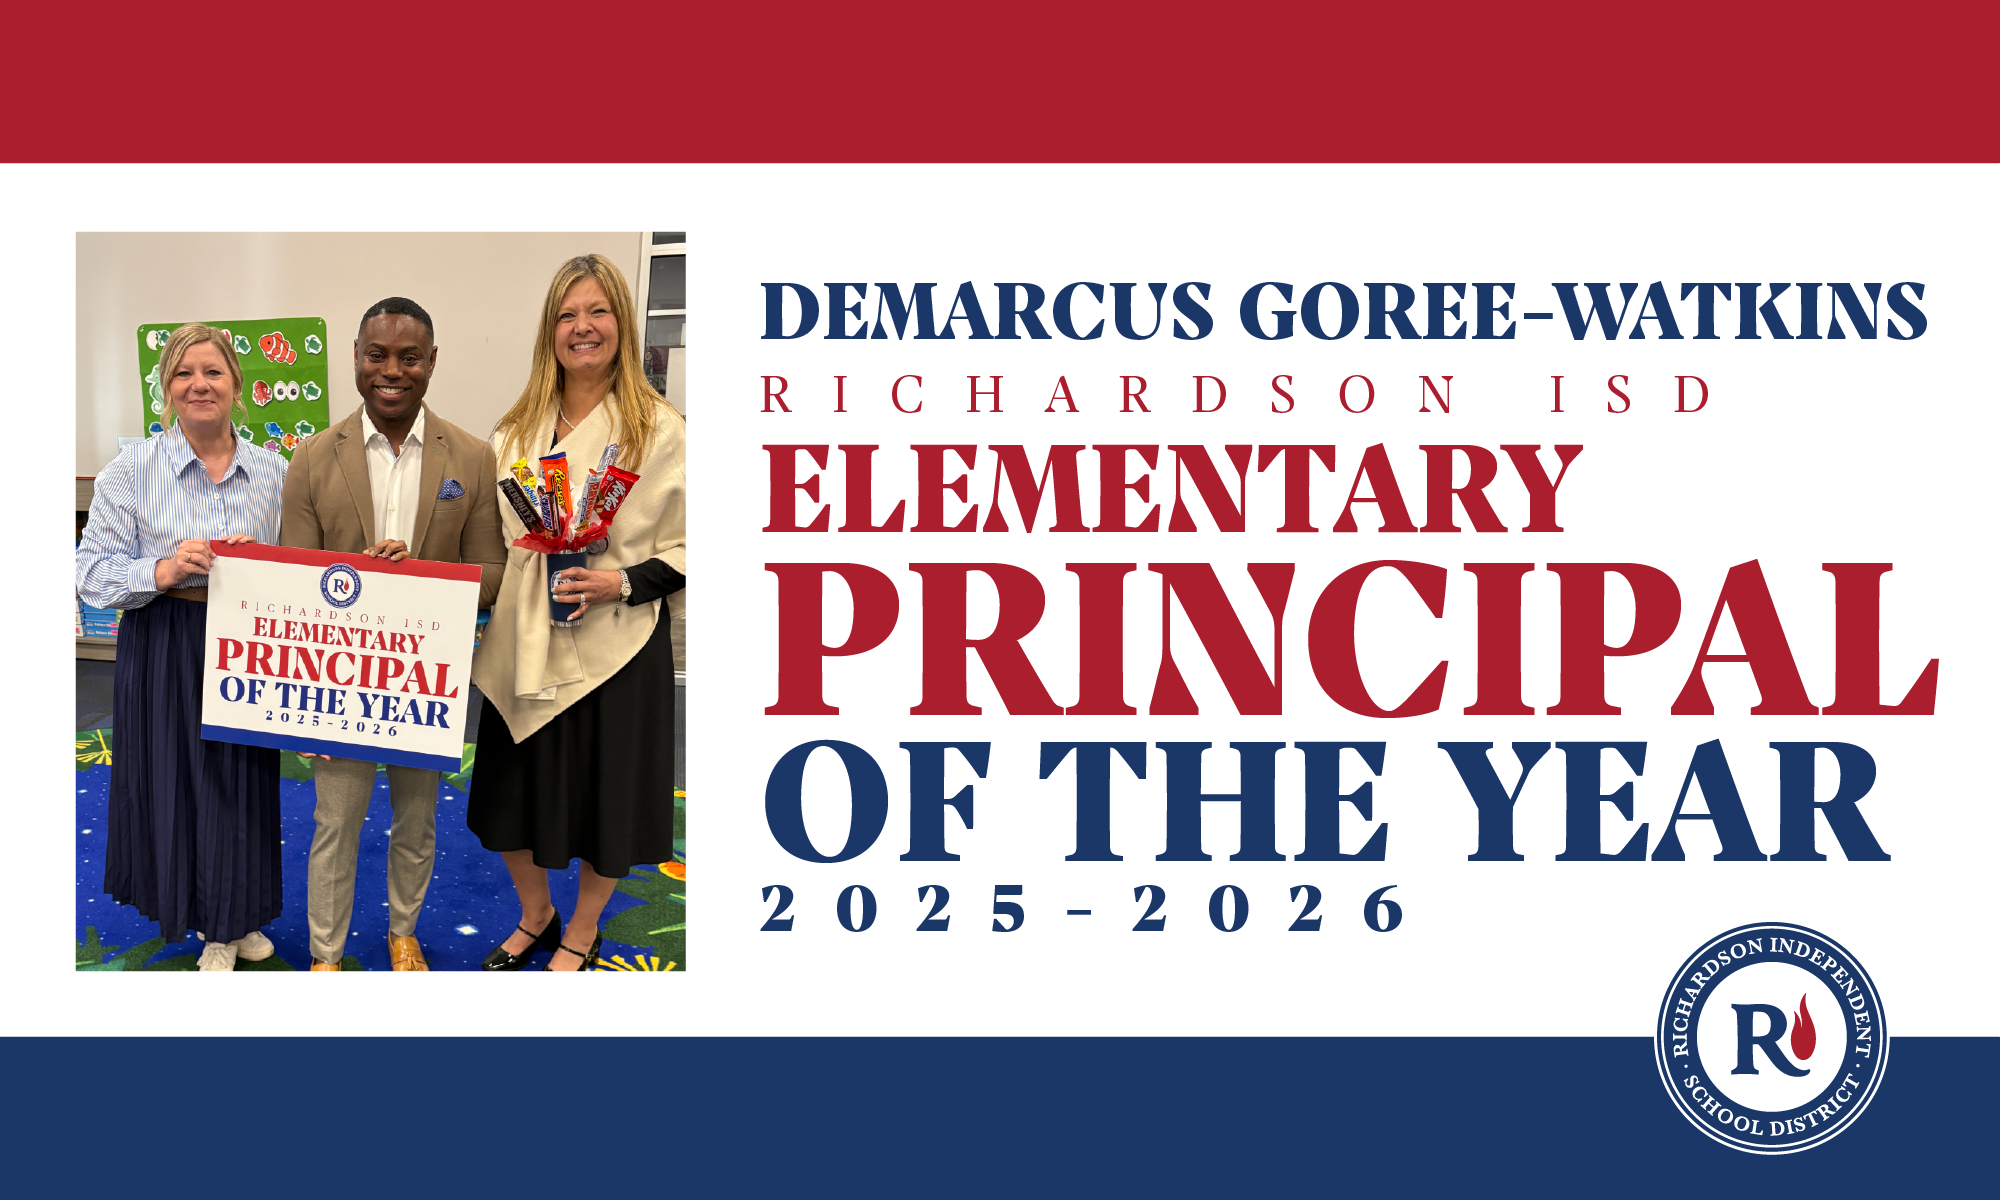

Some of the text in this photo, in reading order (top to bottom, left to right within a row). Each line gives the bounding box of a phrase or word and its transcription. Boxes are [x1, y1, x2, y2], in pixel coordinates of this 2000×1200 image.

[241, 600, 441, 631] RICHARDSON ISD
[253, 616, 425, 655] ELEMENTARY
[215, 637, 459, 699] PRINCIPAL
[219, 676, 450, 729] OF THE YEAR
[265, 710, 398, 737] 2025-2026
